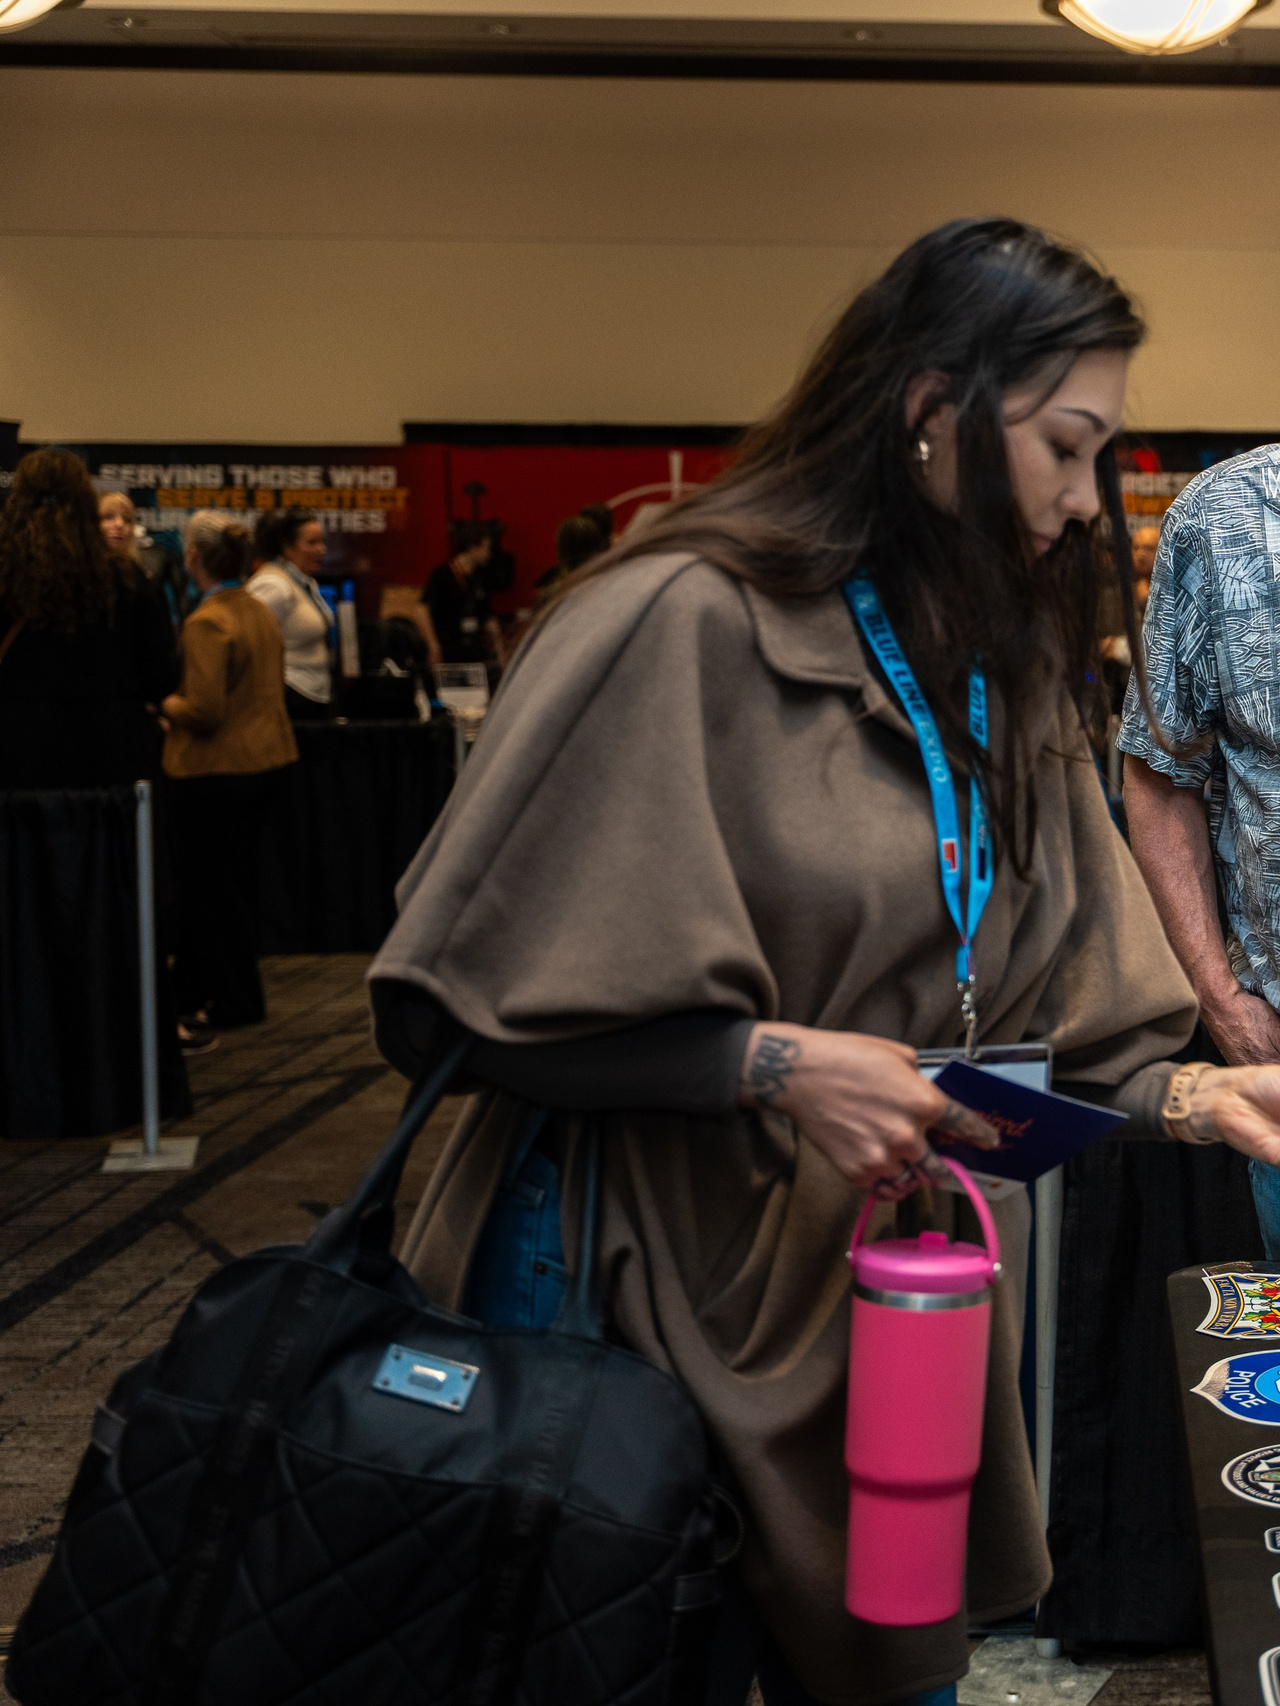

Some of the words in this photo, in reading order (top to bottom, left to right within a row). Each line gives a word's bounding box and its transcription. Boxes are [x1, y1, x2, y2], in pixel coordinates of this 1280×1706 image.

[100, 464, 223, 488] SERVING
[229, 465, 322, 488] THOSE
[328, 466, 397, 488] WHO
[864, 614, 899, 663] BLUE
[1215, 1279, 1236, 1296] FACTA
[1223, 1297, 1238, 1309] NON
[1209, 1310, 1237, 1330] VERBA
[1225, 1370, 1268, 1409] POLICE
